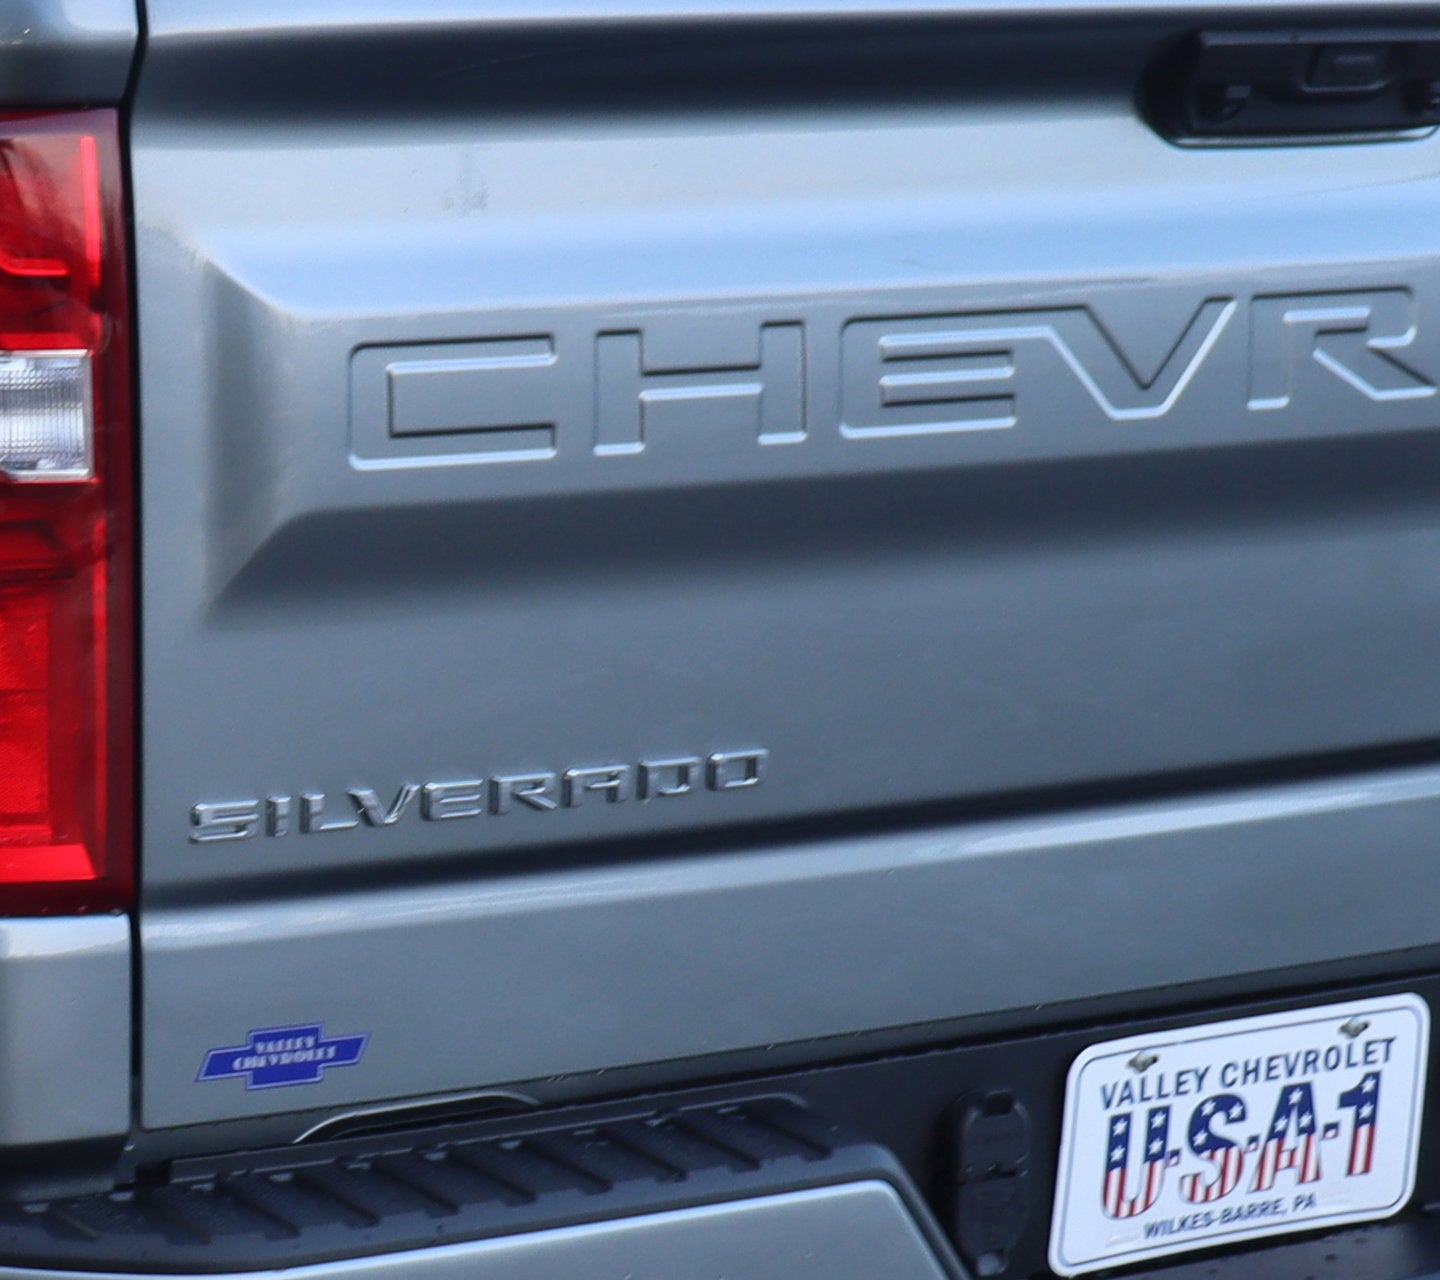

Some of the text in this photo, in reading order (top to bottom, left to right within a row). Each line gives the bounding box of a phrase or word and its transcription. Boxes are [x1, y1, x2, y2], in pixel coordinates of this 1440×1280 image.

[188, 748, 770, 844] SILVERADO
[255, 1035, 317, 1054] VALLEY
[231, 1046, 337, 1070] CHEVROLET
[1100, 1036, 1397, 1110] VALLEY CHEVROLET
[1292, 1193, 1317, 1212] PA
